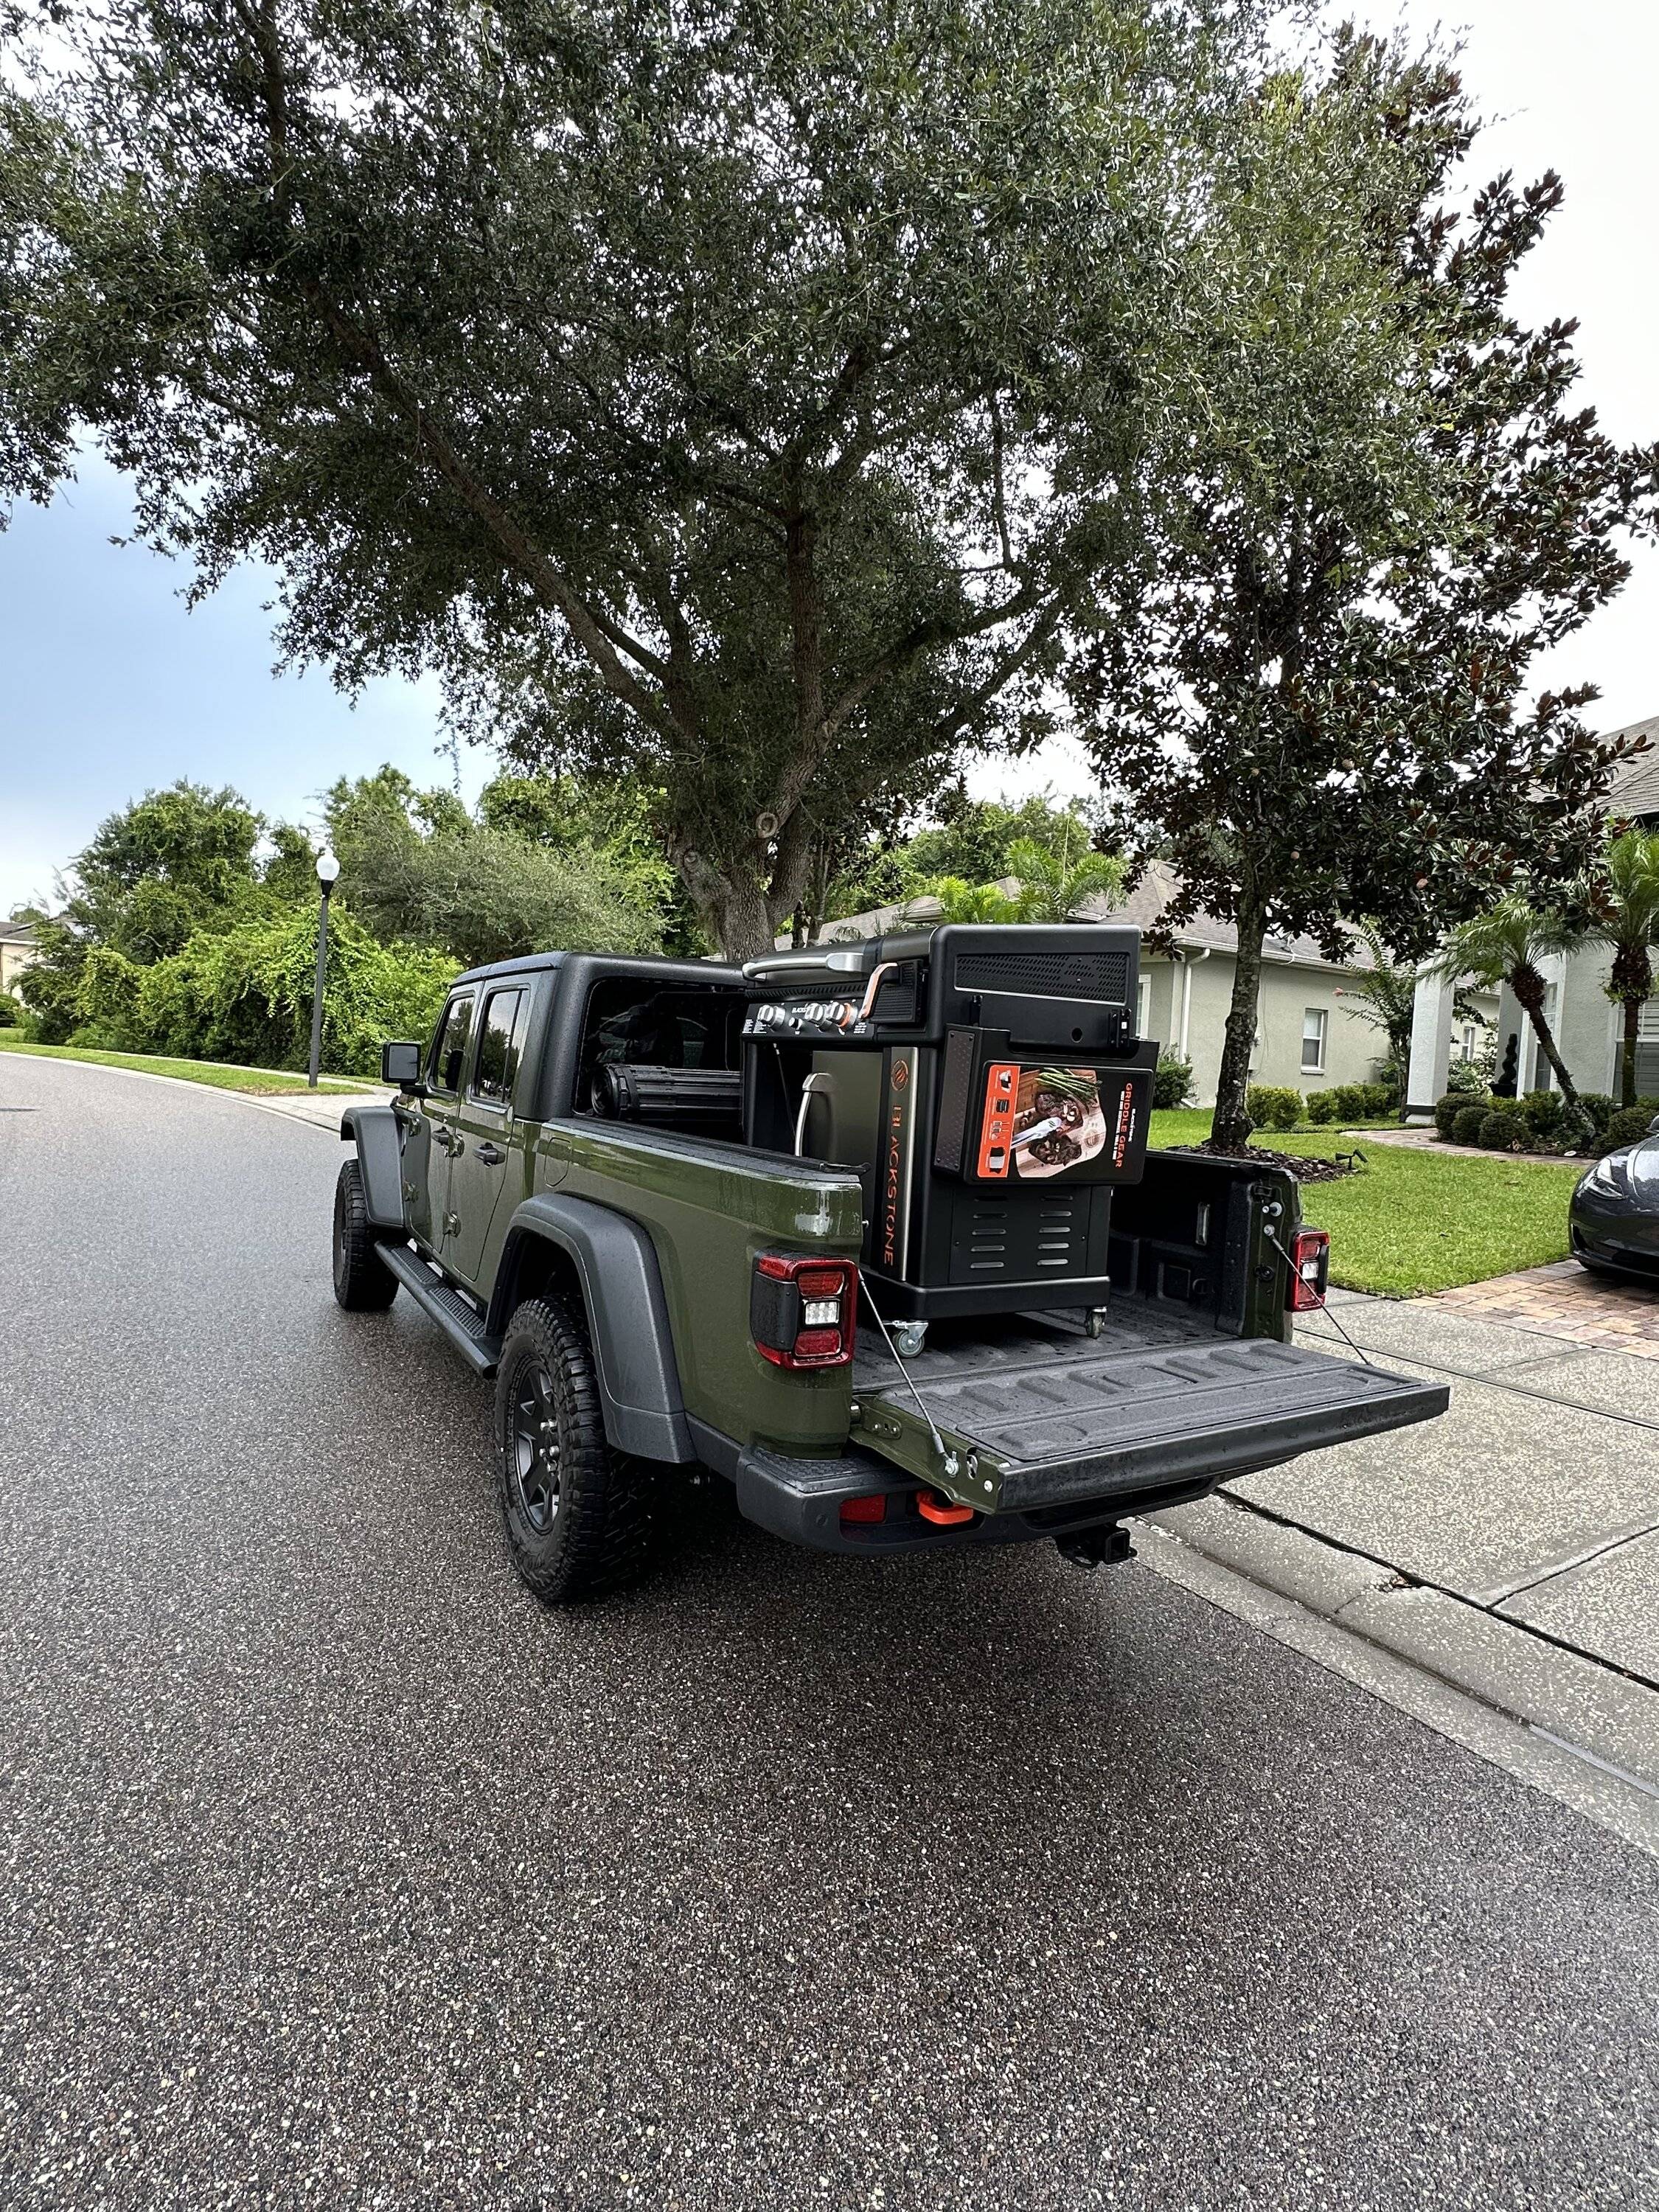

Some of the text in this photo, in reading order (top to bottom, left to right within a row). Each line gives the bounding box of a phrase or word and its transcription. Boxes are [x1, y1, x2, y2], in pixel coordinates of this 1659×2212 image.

[1121, 1082, 1133, 1133] GRIDDLE
[1116, 1135, 1126, 1168] GEAR
[884, 1105, 902, 1266] BLACKSTONE
